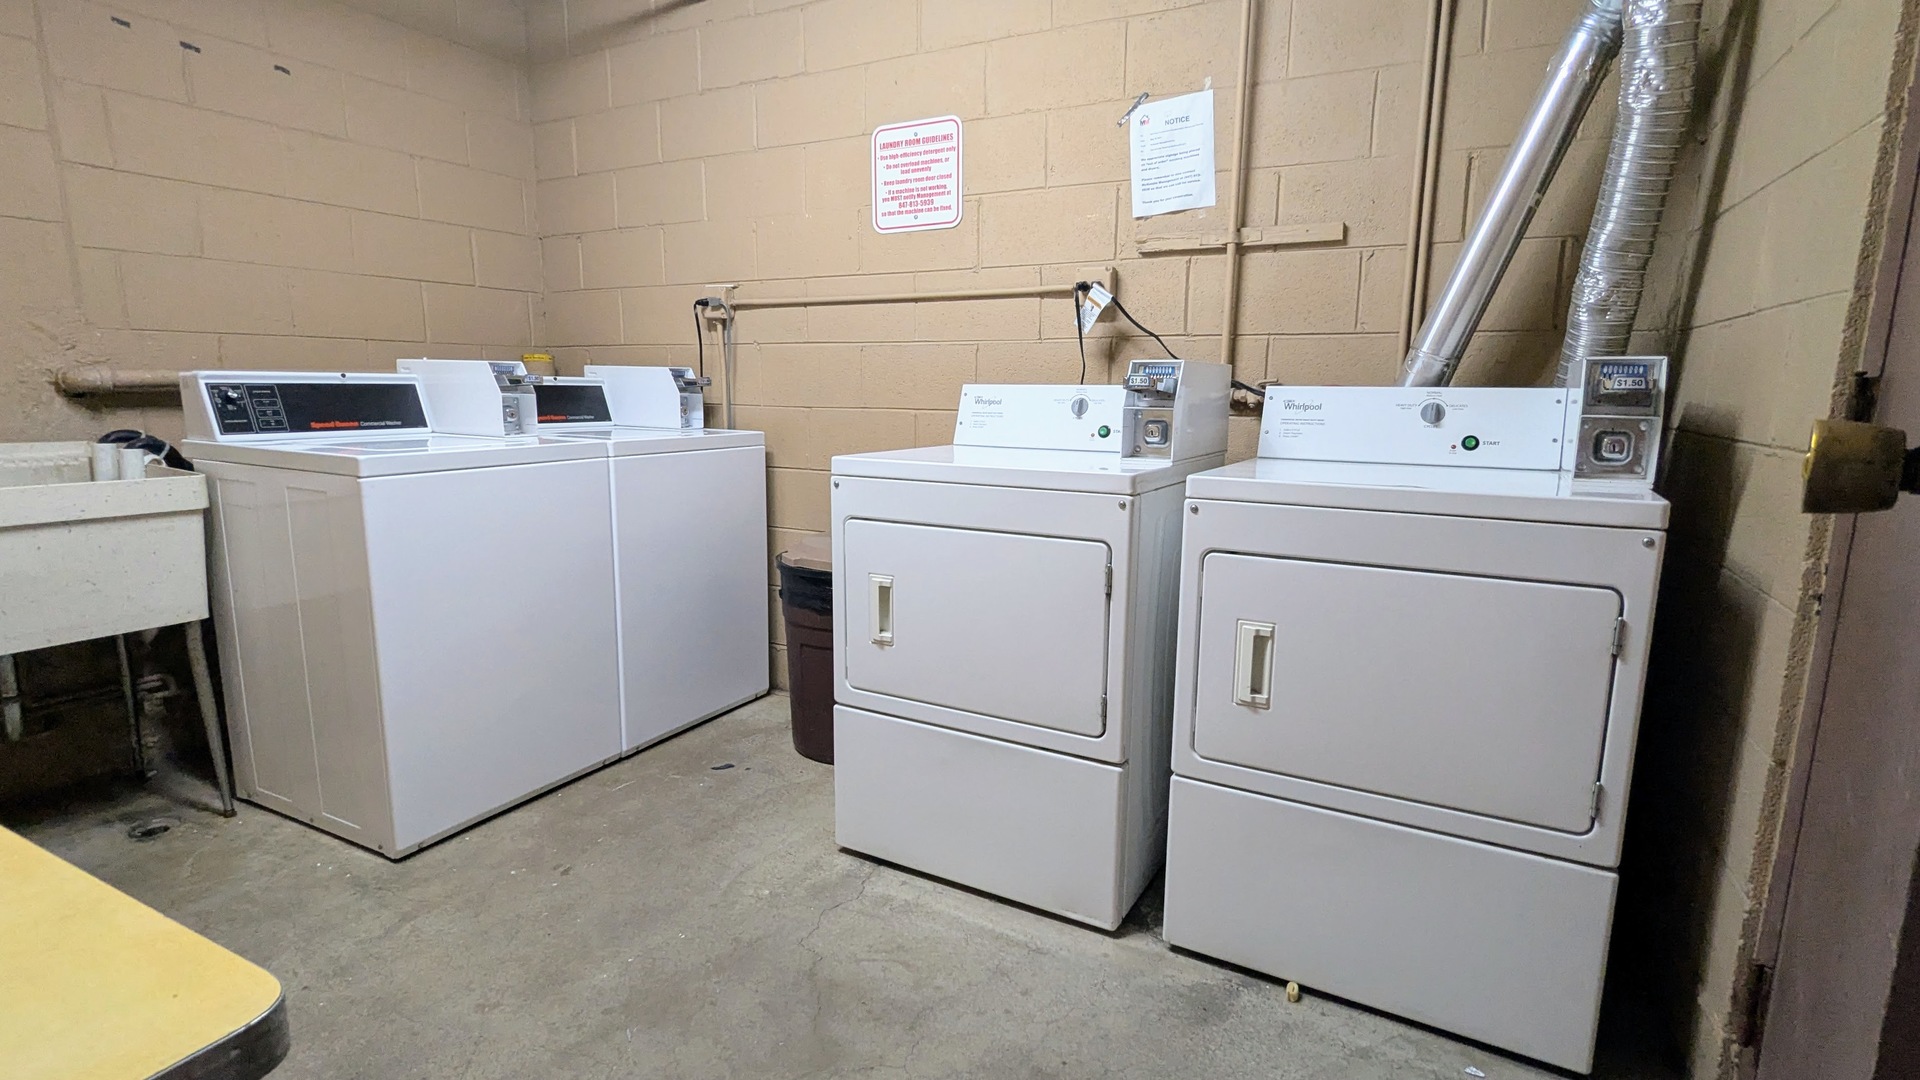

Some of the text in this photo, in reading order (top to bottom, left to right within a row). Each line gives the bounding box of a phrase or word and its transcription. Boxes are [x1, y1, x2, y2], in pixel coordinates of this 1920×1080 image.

[1164, 116, 1190, 126] NOTICE
[880, 133, 953, 150] LAUNDRY ROOM GUIDELINES
[1284, 403, 1322, 412] Whirlpool
